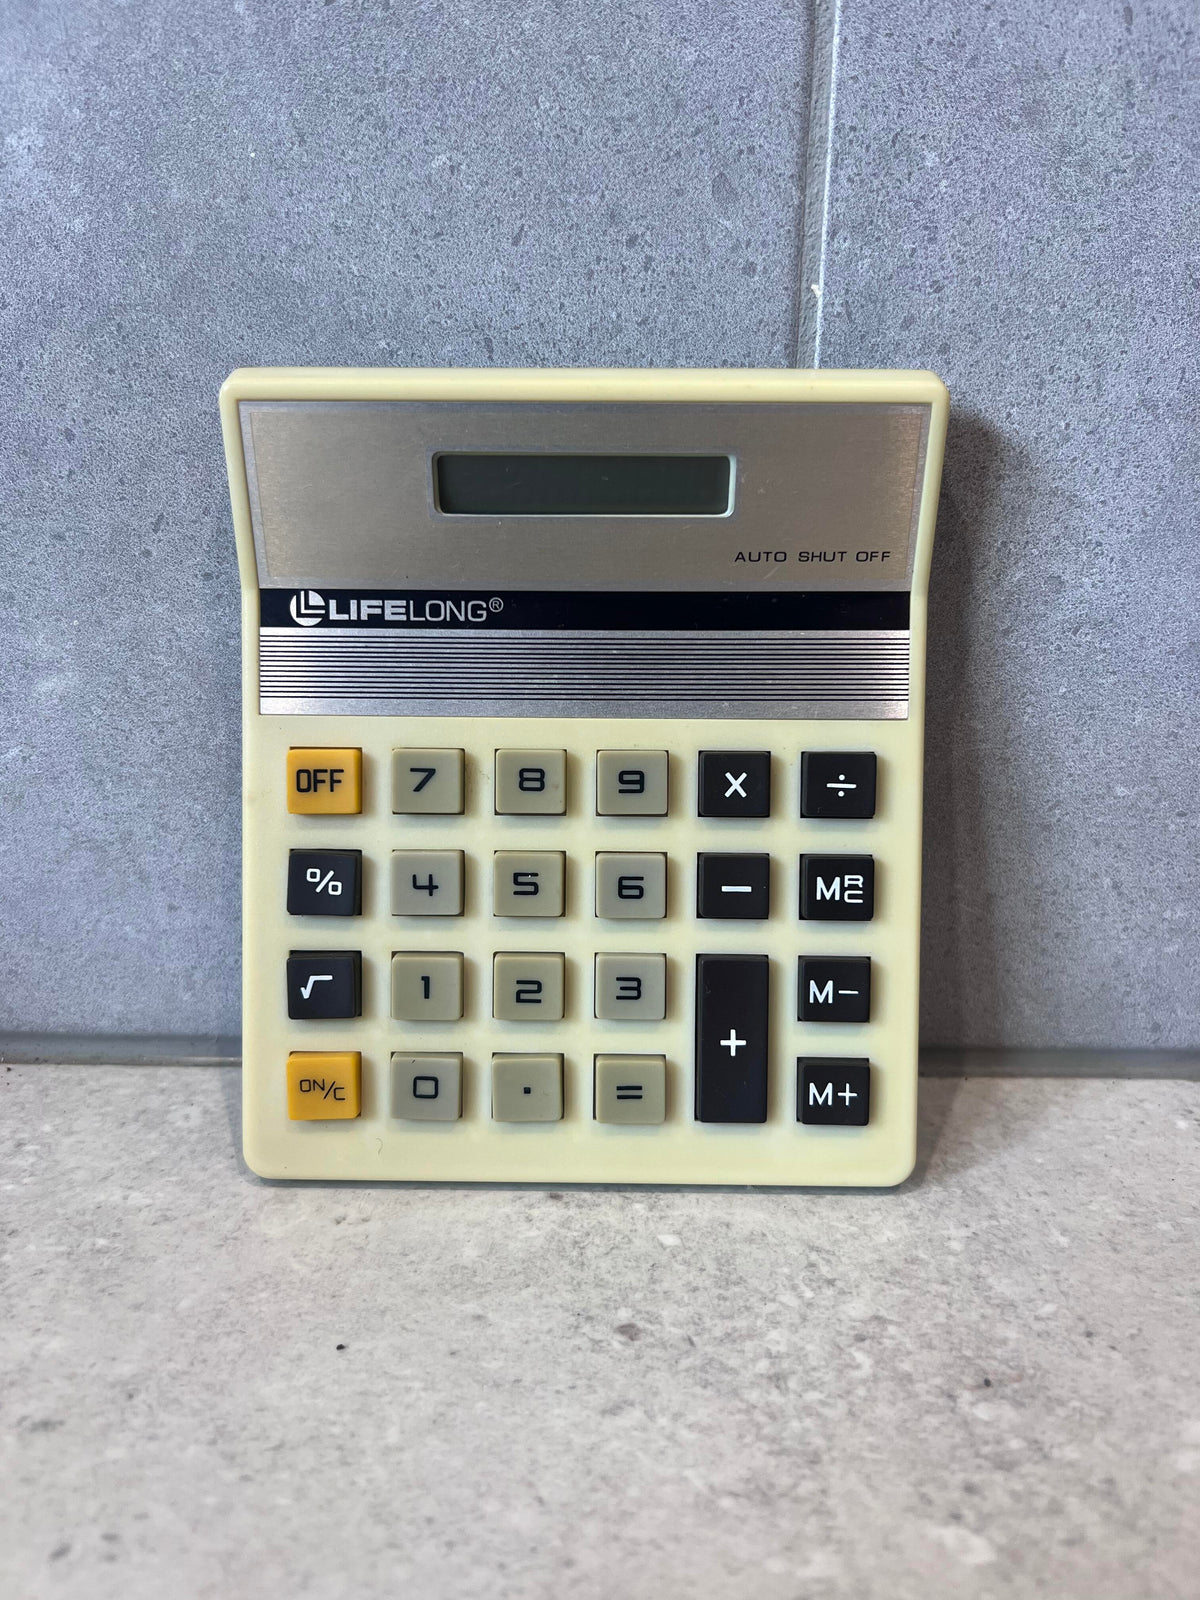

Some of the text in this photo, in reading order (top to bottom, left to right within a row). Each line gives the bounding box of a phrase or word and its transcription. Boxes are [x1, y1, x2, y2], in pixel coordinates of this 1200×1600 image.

[734, 551, 891, 563] AUTO SHUT OFF
[297, 769, 345, 793] OFF
[410, 768, 437, 792] 7
[519, 768, 546, 792] 8
[619, 771, 645, 793] 9
[306, 868, 343, 896] %
[412, 873, 439, 897] 4
[512, 872, 540, 896] 5
[617, 875, 645, 900] 6
[420, 975, 431, 1000] 1
[515, 979, 543, 1004] 2
[615, 976, 642, 1000] 3
[719, 1028, 747, 1057] +
[299, 1078, 346, 1101] ON/C
[412, 1075, 439, 1100] 0
[616, 1085, 643, 1100] =
[808, 1082, 858, 1106] M+
